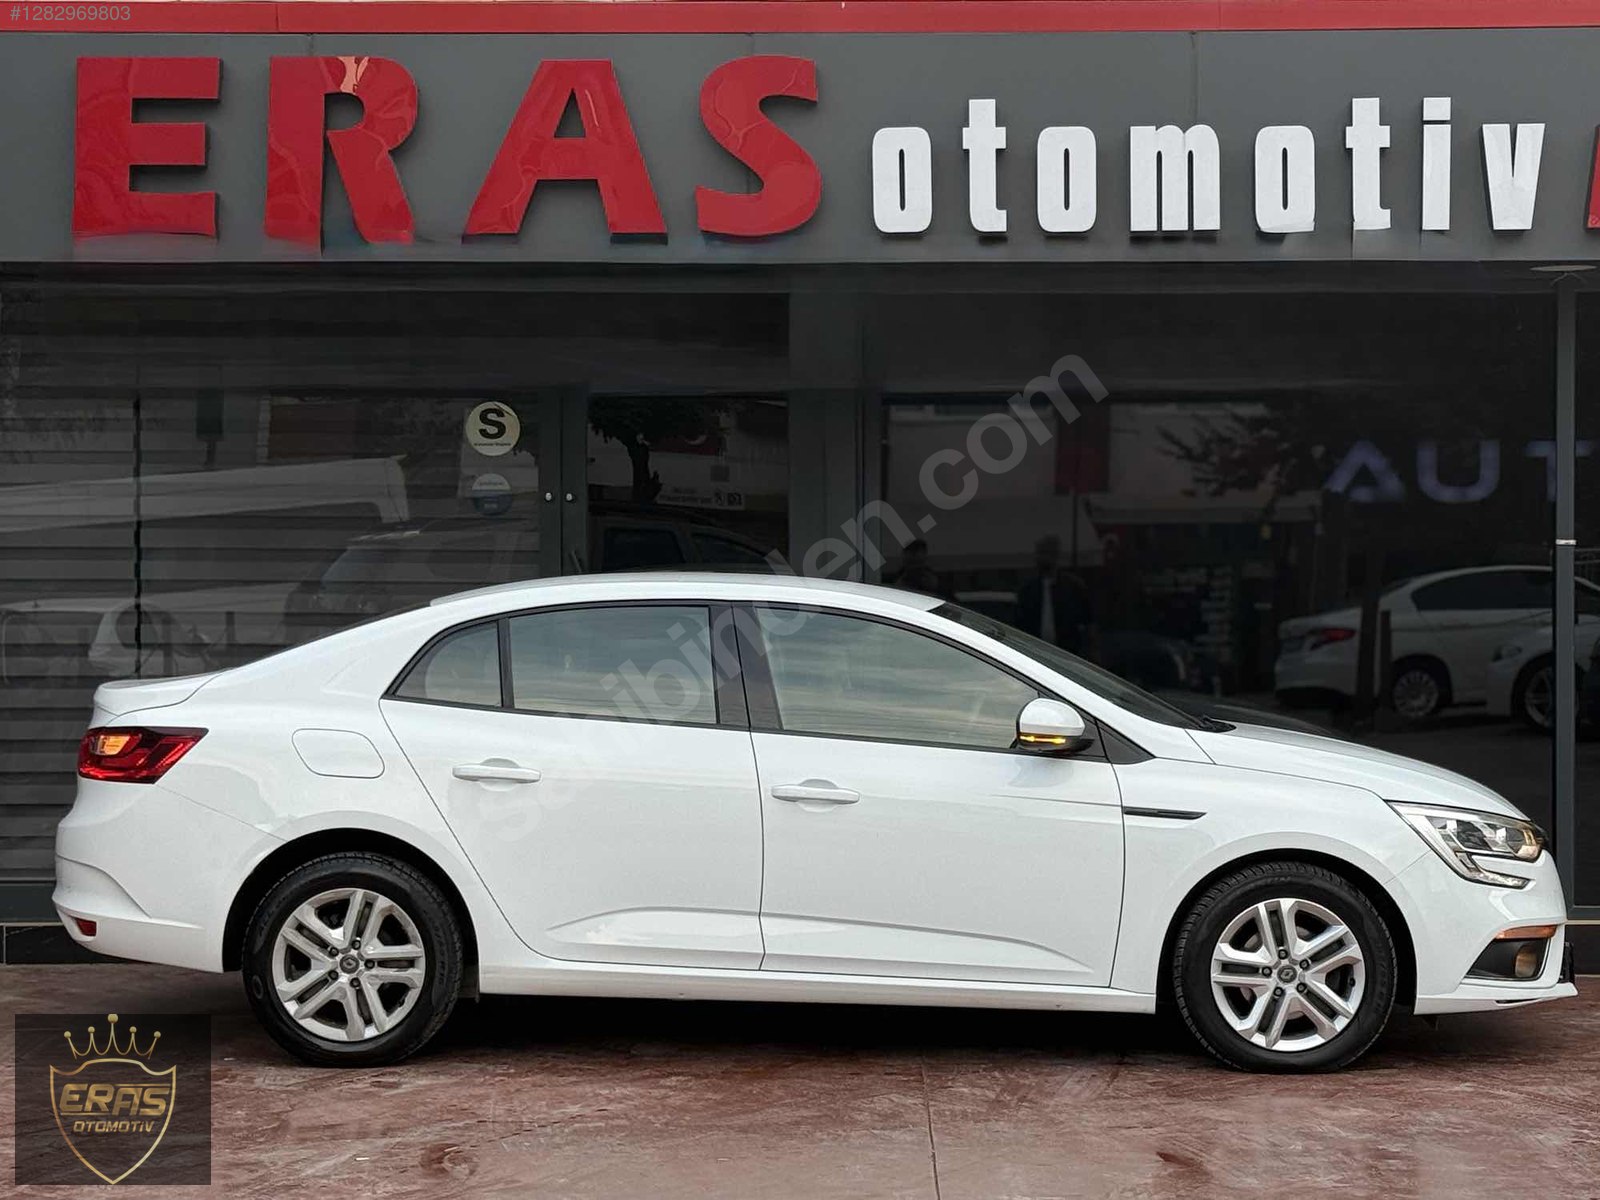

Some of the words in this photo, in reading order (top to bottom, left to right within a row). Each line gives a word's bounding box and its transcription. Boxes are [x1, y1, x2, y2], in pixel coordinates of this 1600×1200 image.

[72, 55, 823, 245] ERAS
[872, 97, 1546, 234] otomotiv
[478, 407, 507, 440] S
